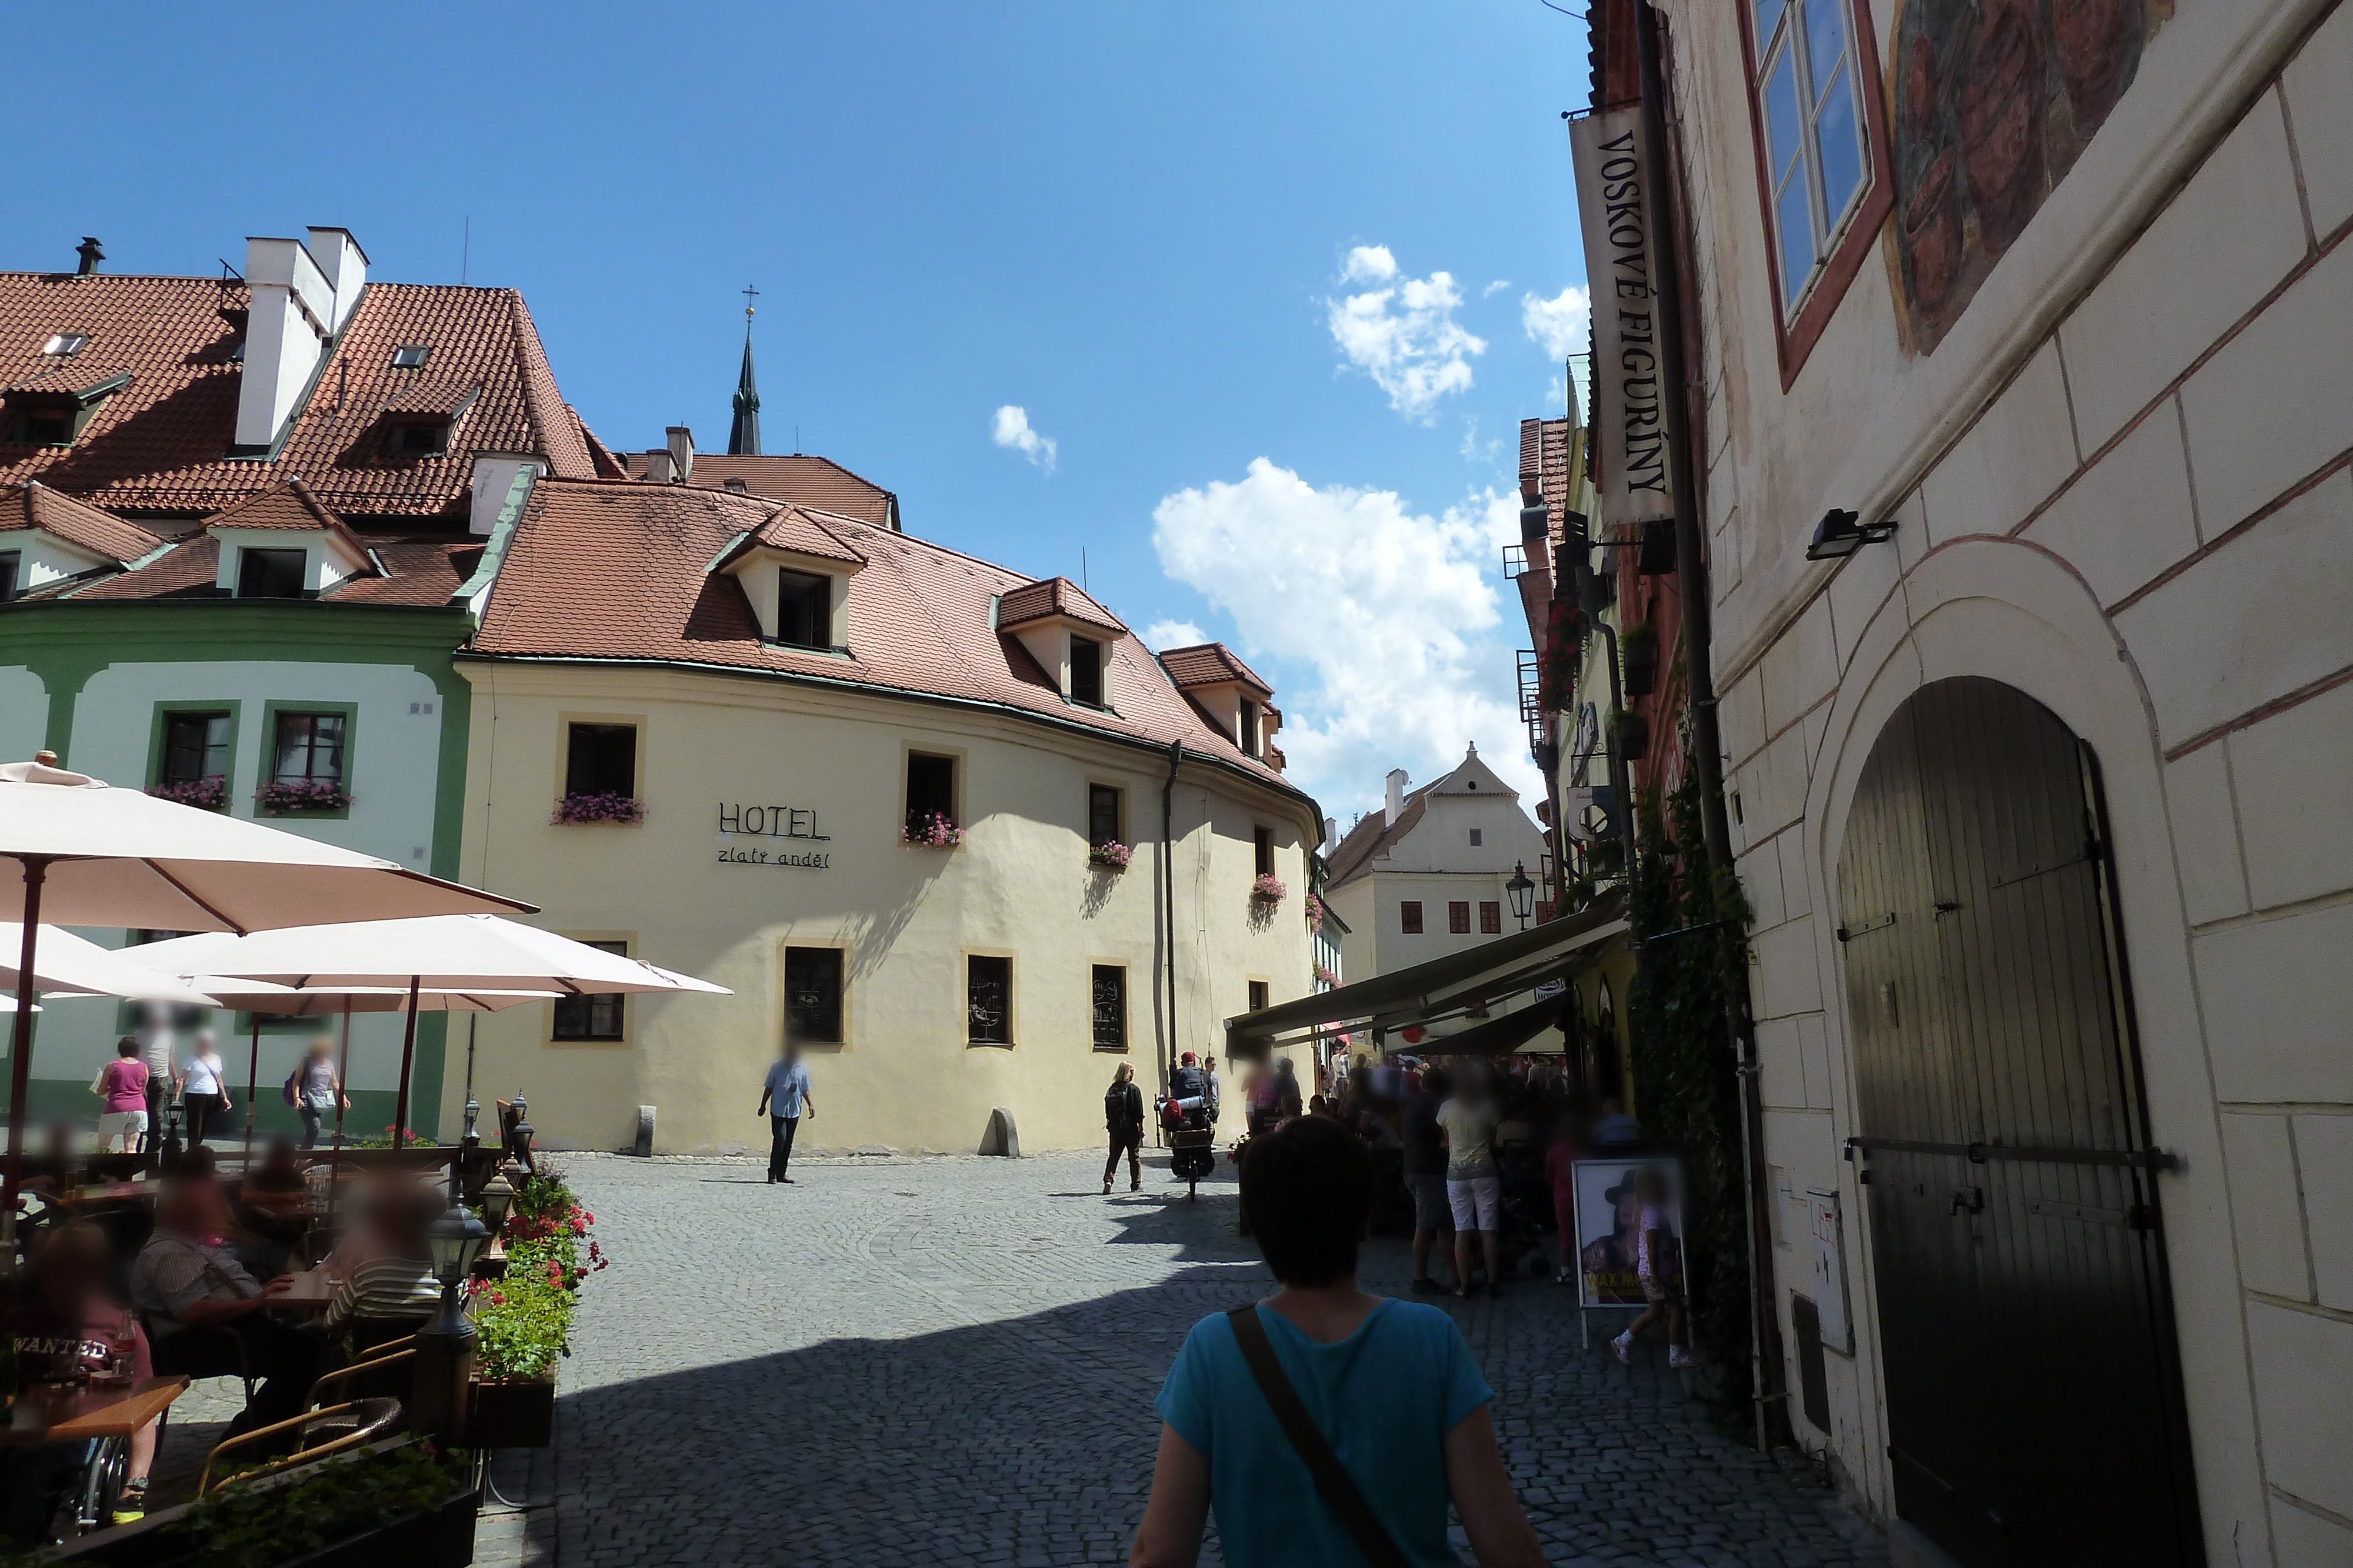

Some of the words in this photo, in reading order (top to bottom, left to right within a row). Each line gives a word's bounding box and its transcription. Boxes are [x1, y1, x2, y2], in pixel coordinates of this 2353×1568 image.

[1597, 129, 1658, 299] VOSKOVÉ
[1618, 308, 1669, 495] FIGURÍNY
[719, 802, 830, 840] HOTEL
[718, 847, 768, 863] zlatý
[778, 852, 829, 868] anděl
[1537, 992, 1557, 1001] HOT
[12, 1336, 107, 1359] WANTED
